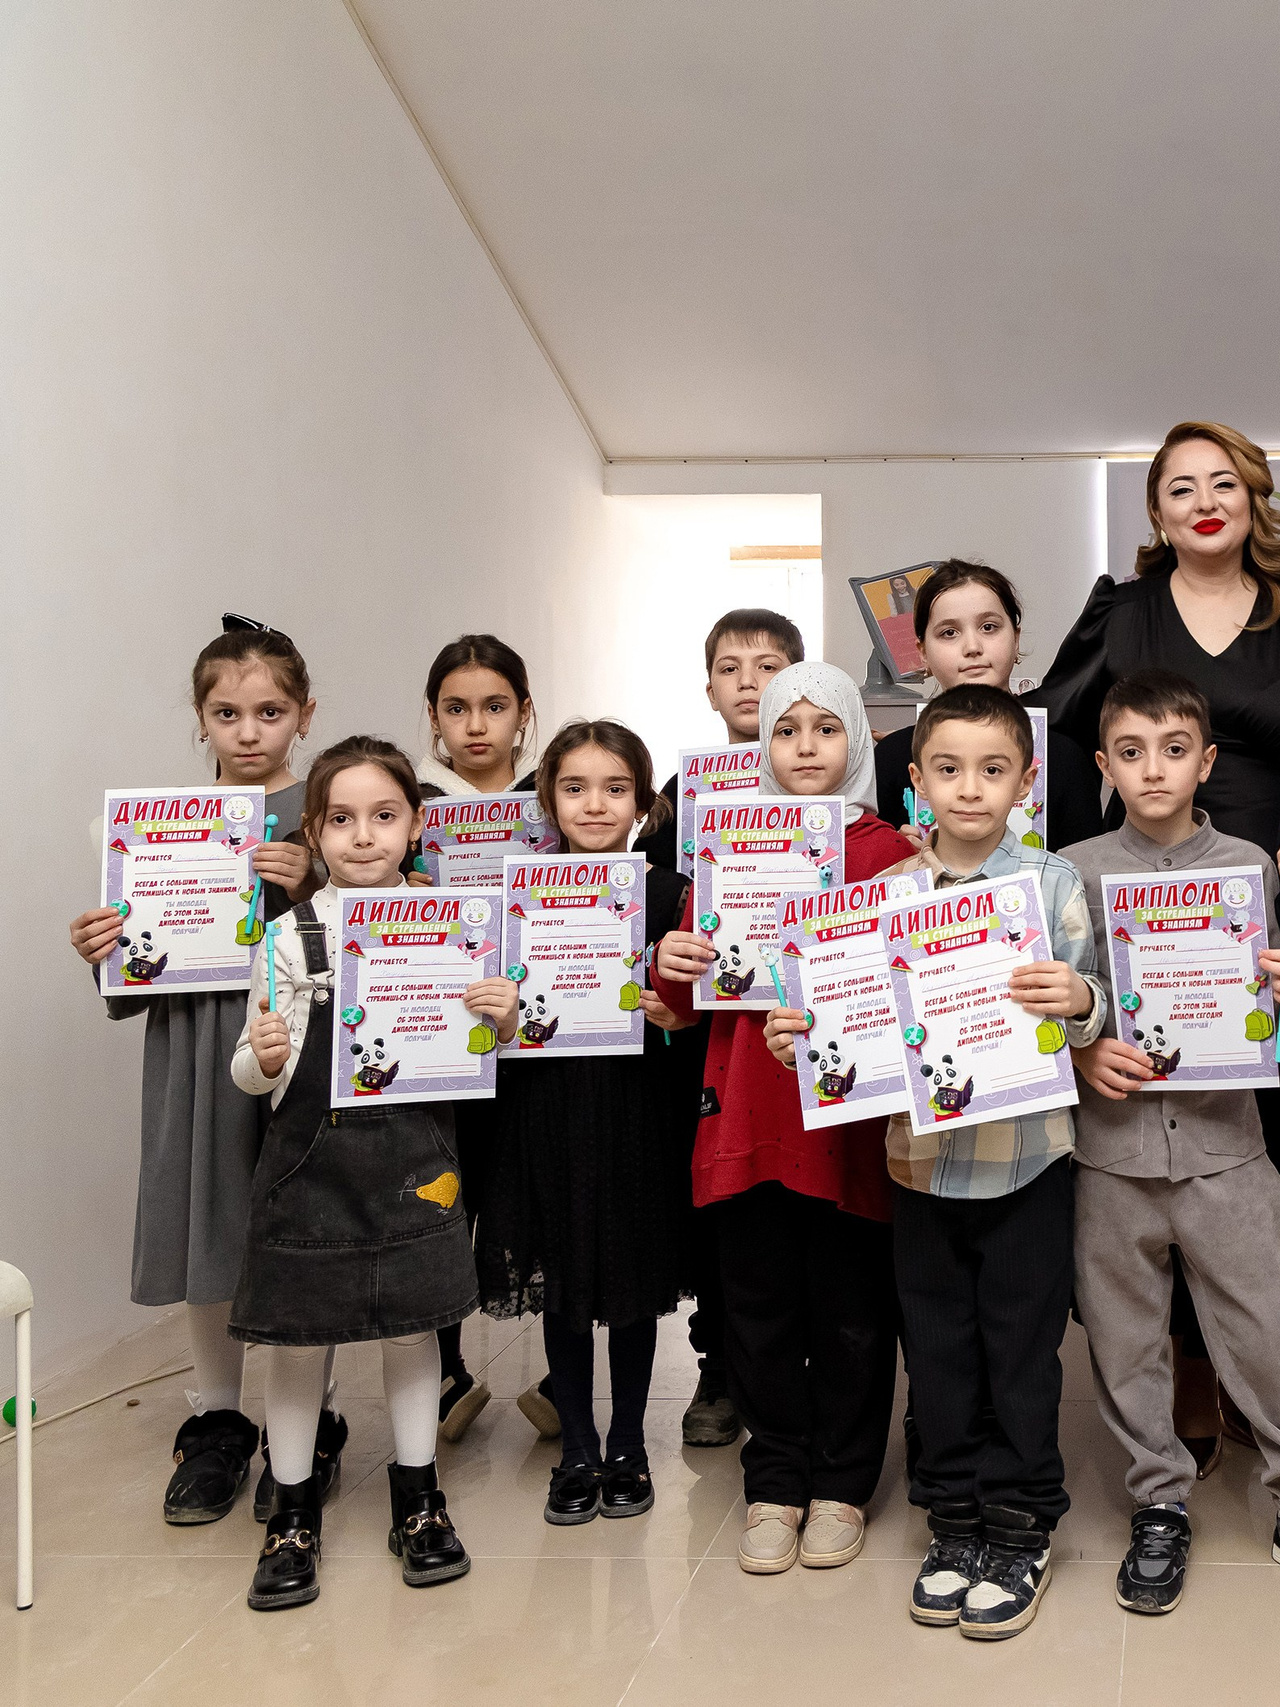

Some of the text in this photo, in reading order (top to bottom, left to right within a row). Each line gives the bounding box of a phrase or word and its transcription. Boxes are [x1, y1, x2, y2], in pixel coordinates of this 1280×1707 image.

[707, 773, 717, 782] ЗА
[723, 778, 755, 787] ЗНАНИЯМ
[111, 797, 222, 826] ДИПЛОМ
[424, 801, 521, 829] ДИПЛОМ
[699, 805, 802, 834] ДИПЛОМ
[140, 820, 214, 832] ЗА СТРЕМЛЕНИЕ
[450, 821, 515, 834] ЗА СТРЕМЛЕНИЕ
[161, 831, 201, 840] ЗНАНИЯМ
[469, 832, 504, 840] ЗНАНИЯМ
[726, 830, 795, 841] ЗА СТРЕМЛЕНИЕ
[745, 841, 783, 850] ЗНАНИЯМ
[135, 854, 172, 862] ВРУЧАЕТСЯ
[510, 863, 609, 890] ДИПЛОМ
[535, 886, 601, 897] ЗА СТРЕМЛЕНИЕ
[1112, 880, 1220, 914] ДИПЛОМ
[554, 897, 590, 905] ЗНАНИЯМ
[781, 880, 887, 928] ДИПЛОМ
[346, 898, 460, 926] ДИПЛОМ
[887, 891, 995, 942] ДИПЛОМ
[1140, 906, 1214, 920] ЗА СТРЕМЛЕНИЕ
[375, 923, 451, 934] ЗА СТРЕМЛЕНИЕ
[809, 919, 822, 931] ЗА
[1153, 918, 1202, 929] К ЗНАНИЯМ
[822, 921, 870, 939] К ЗНАНИЯМ
[916, 917, 990, 944] ЗА СТРЕМЛЕНИЕ
[387, 934, 438, 943] К ЗНАНИЯМ
[930, 932, 980, 952] К ЗНАНИЯМ
[369, 957, 408, 965] ВРУЧАЕТСЯ
